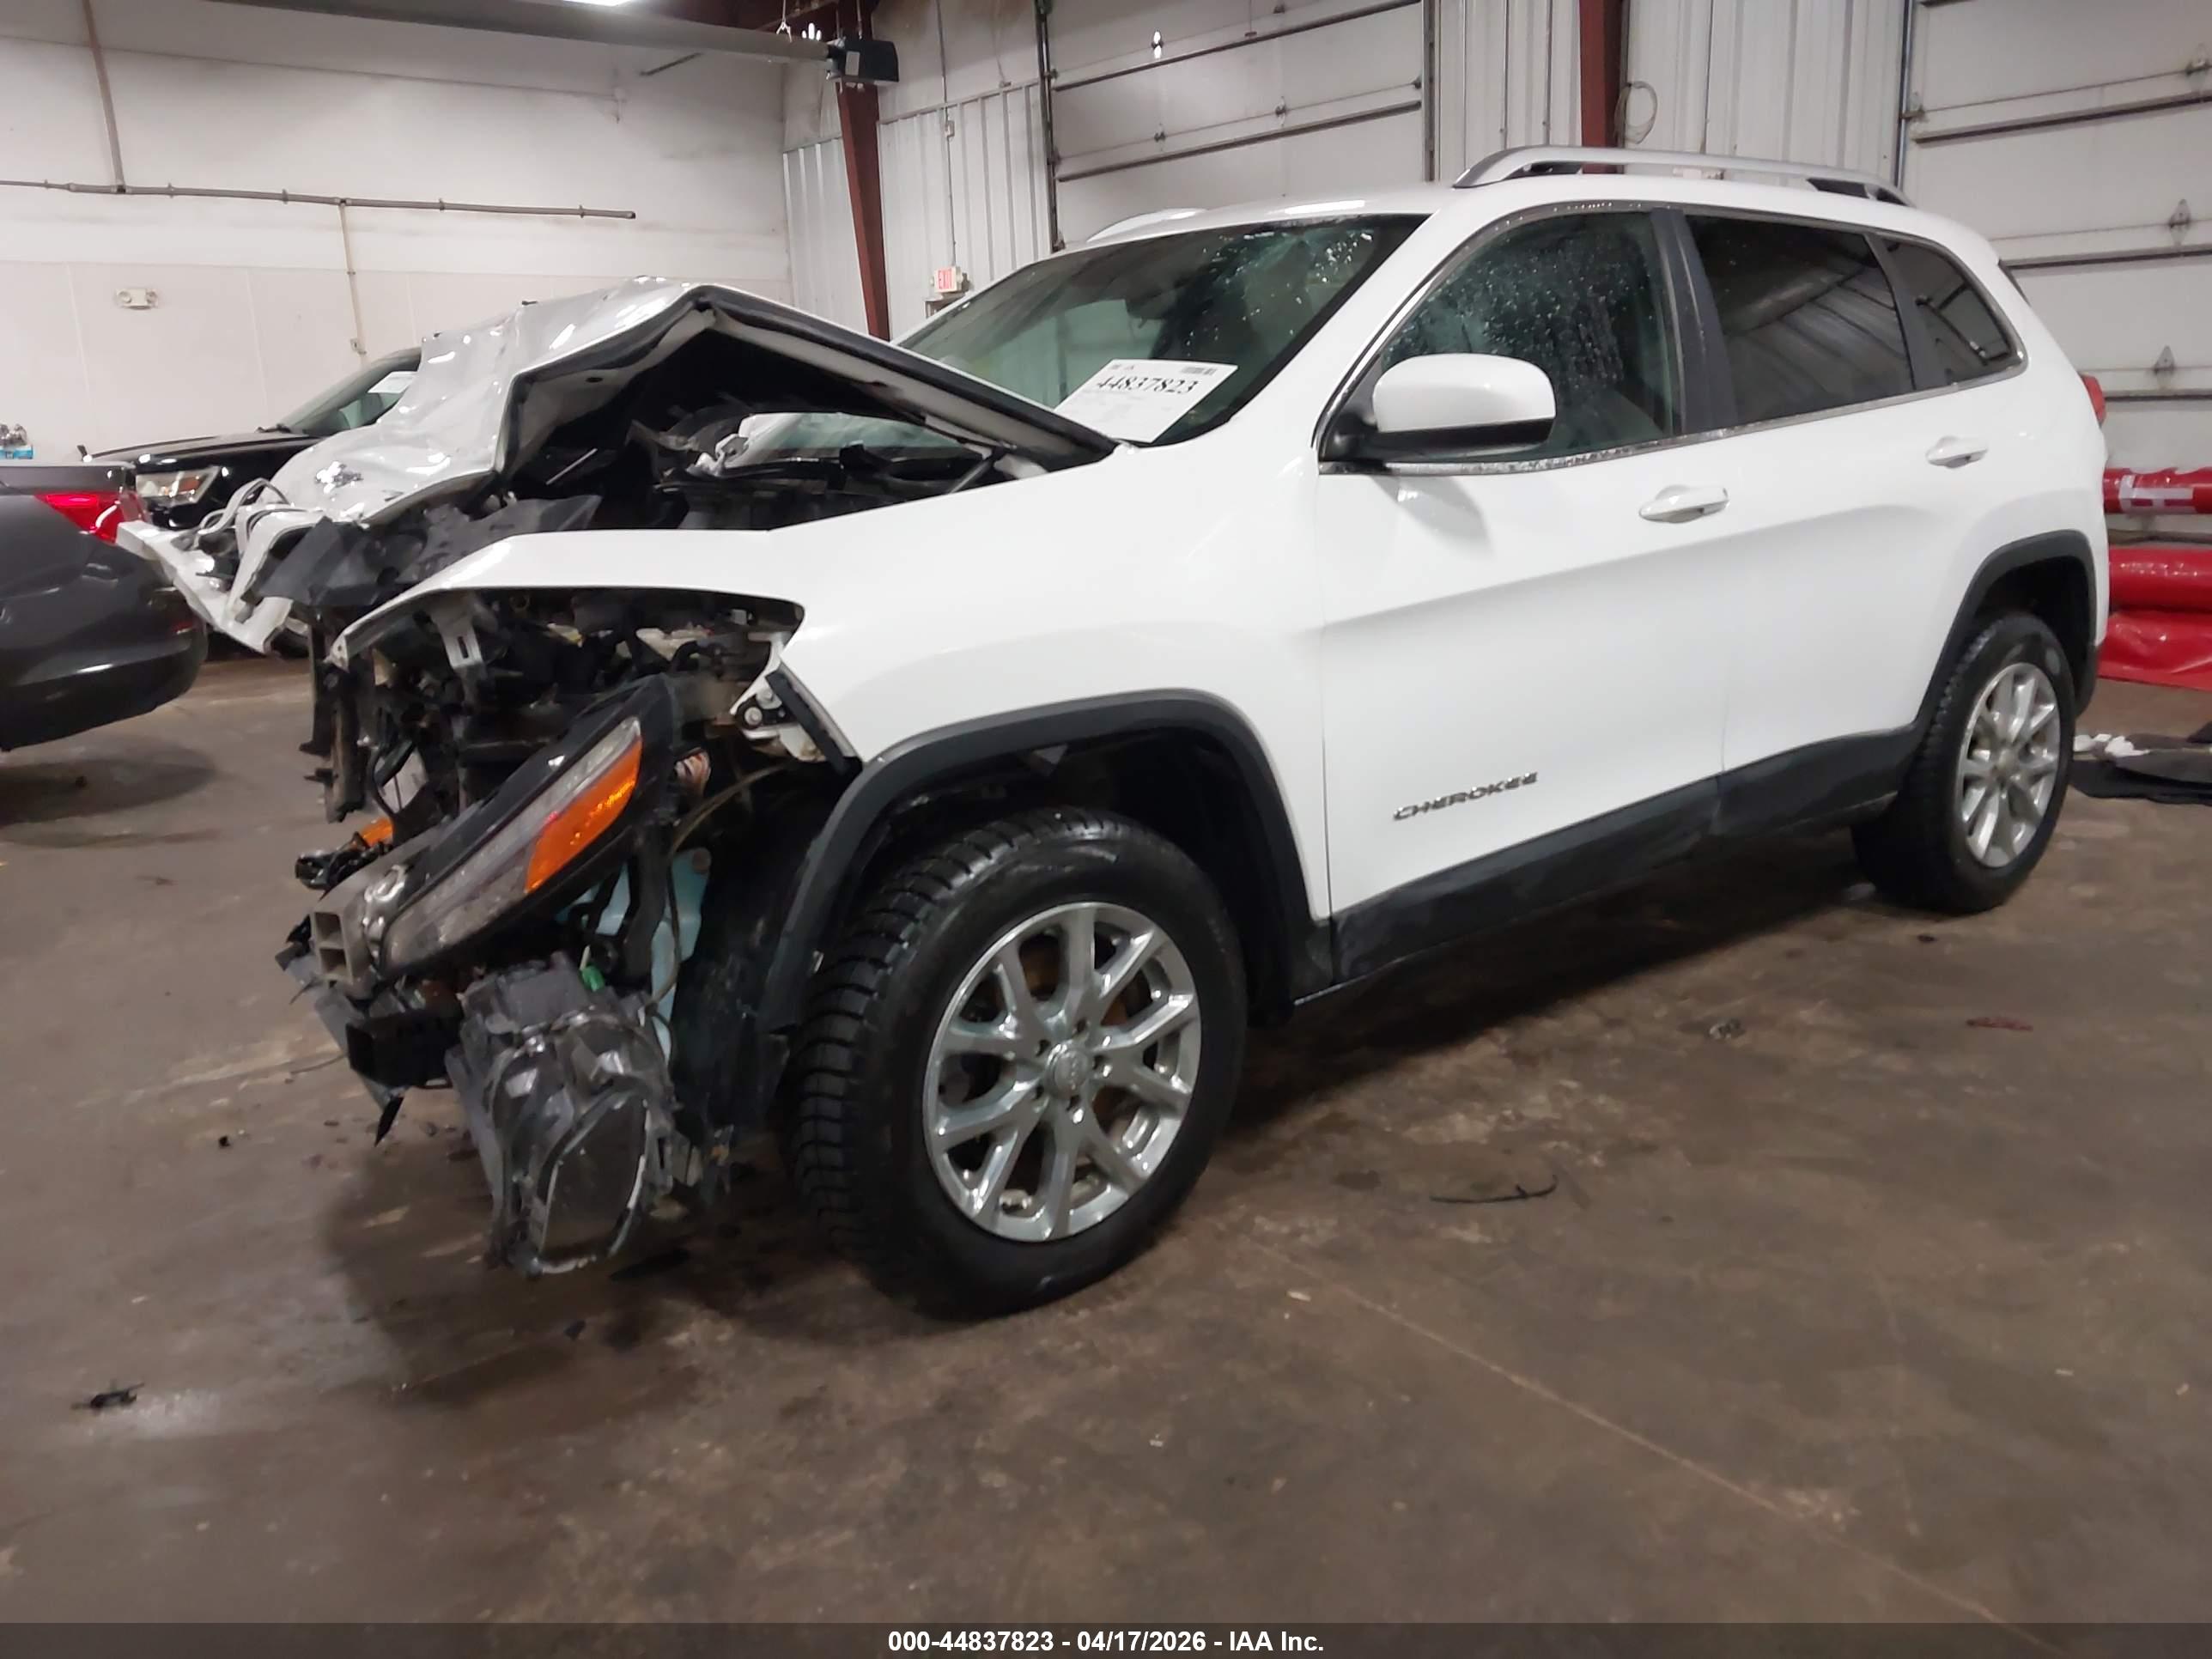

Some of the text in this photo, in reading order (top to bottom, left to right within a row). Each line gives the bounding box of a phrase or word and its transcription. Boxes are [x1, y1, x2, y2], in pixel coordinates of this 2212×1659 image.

[938, 268, 953, 289] EXIT
[1098, 375, 1199, 394] 44837823
[1394, 772, 1537, 820] CHEROKEE
